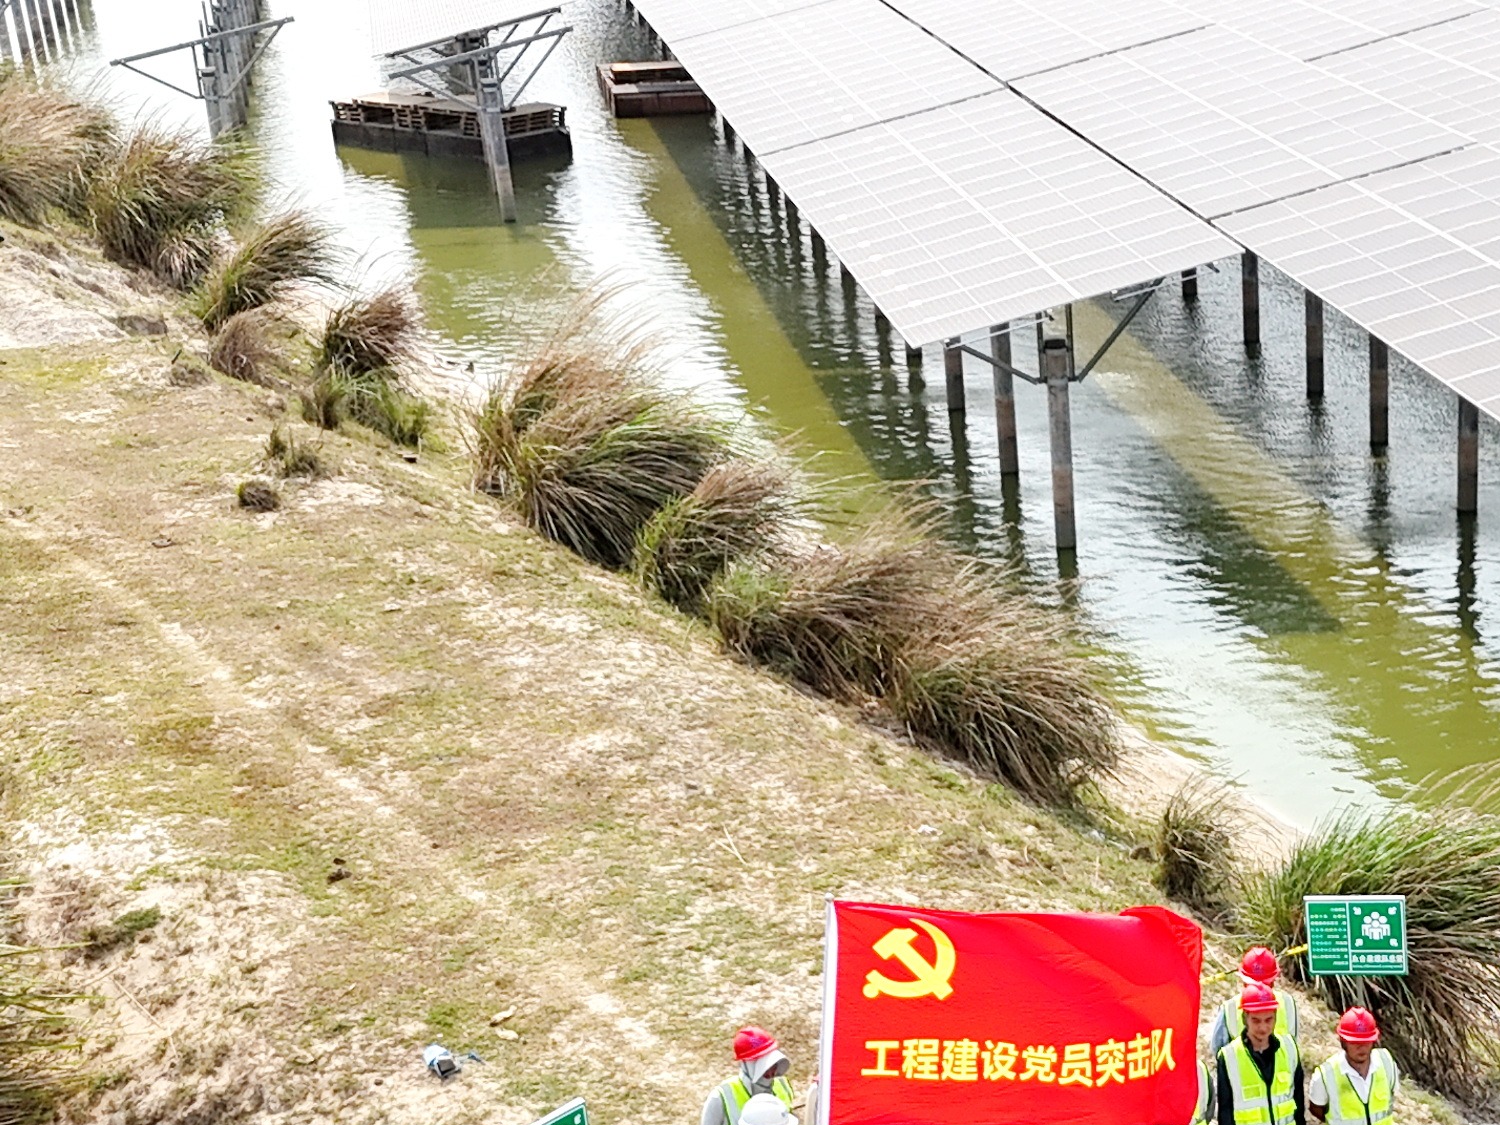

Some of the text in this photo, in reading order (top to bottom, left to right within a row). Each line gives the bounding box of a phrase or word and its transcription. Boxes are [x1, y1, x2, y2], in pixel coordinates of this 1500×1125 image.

[861, 1027, 1176, 1087] 工程建设党员突击队
